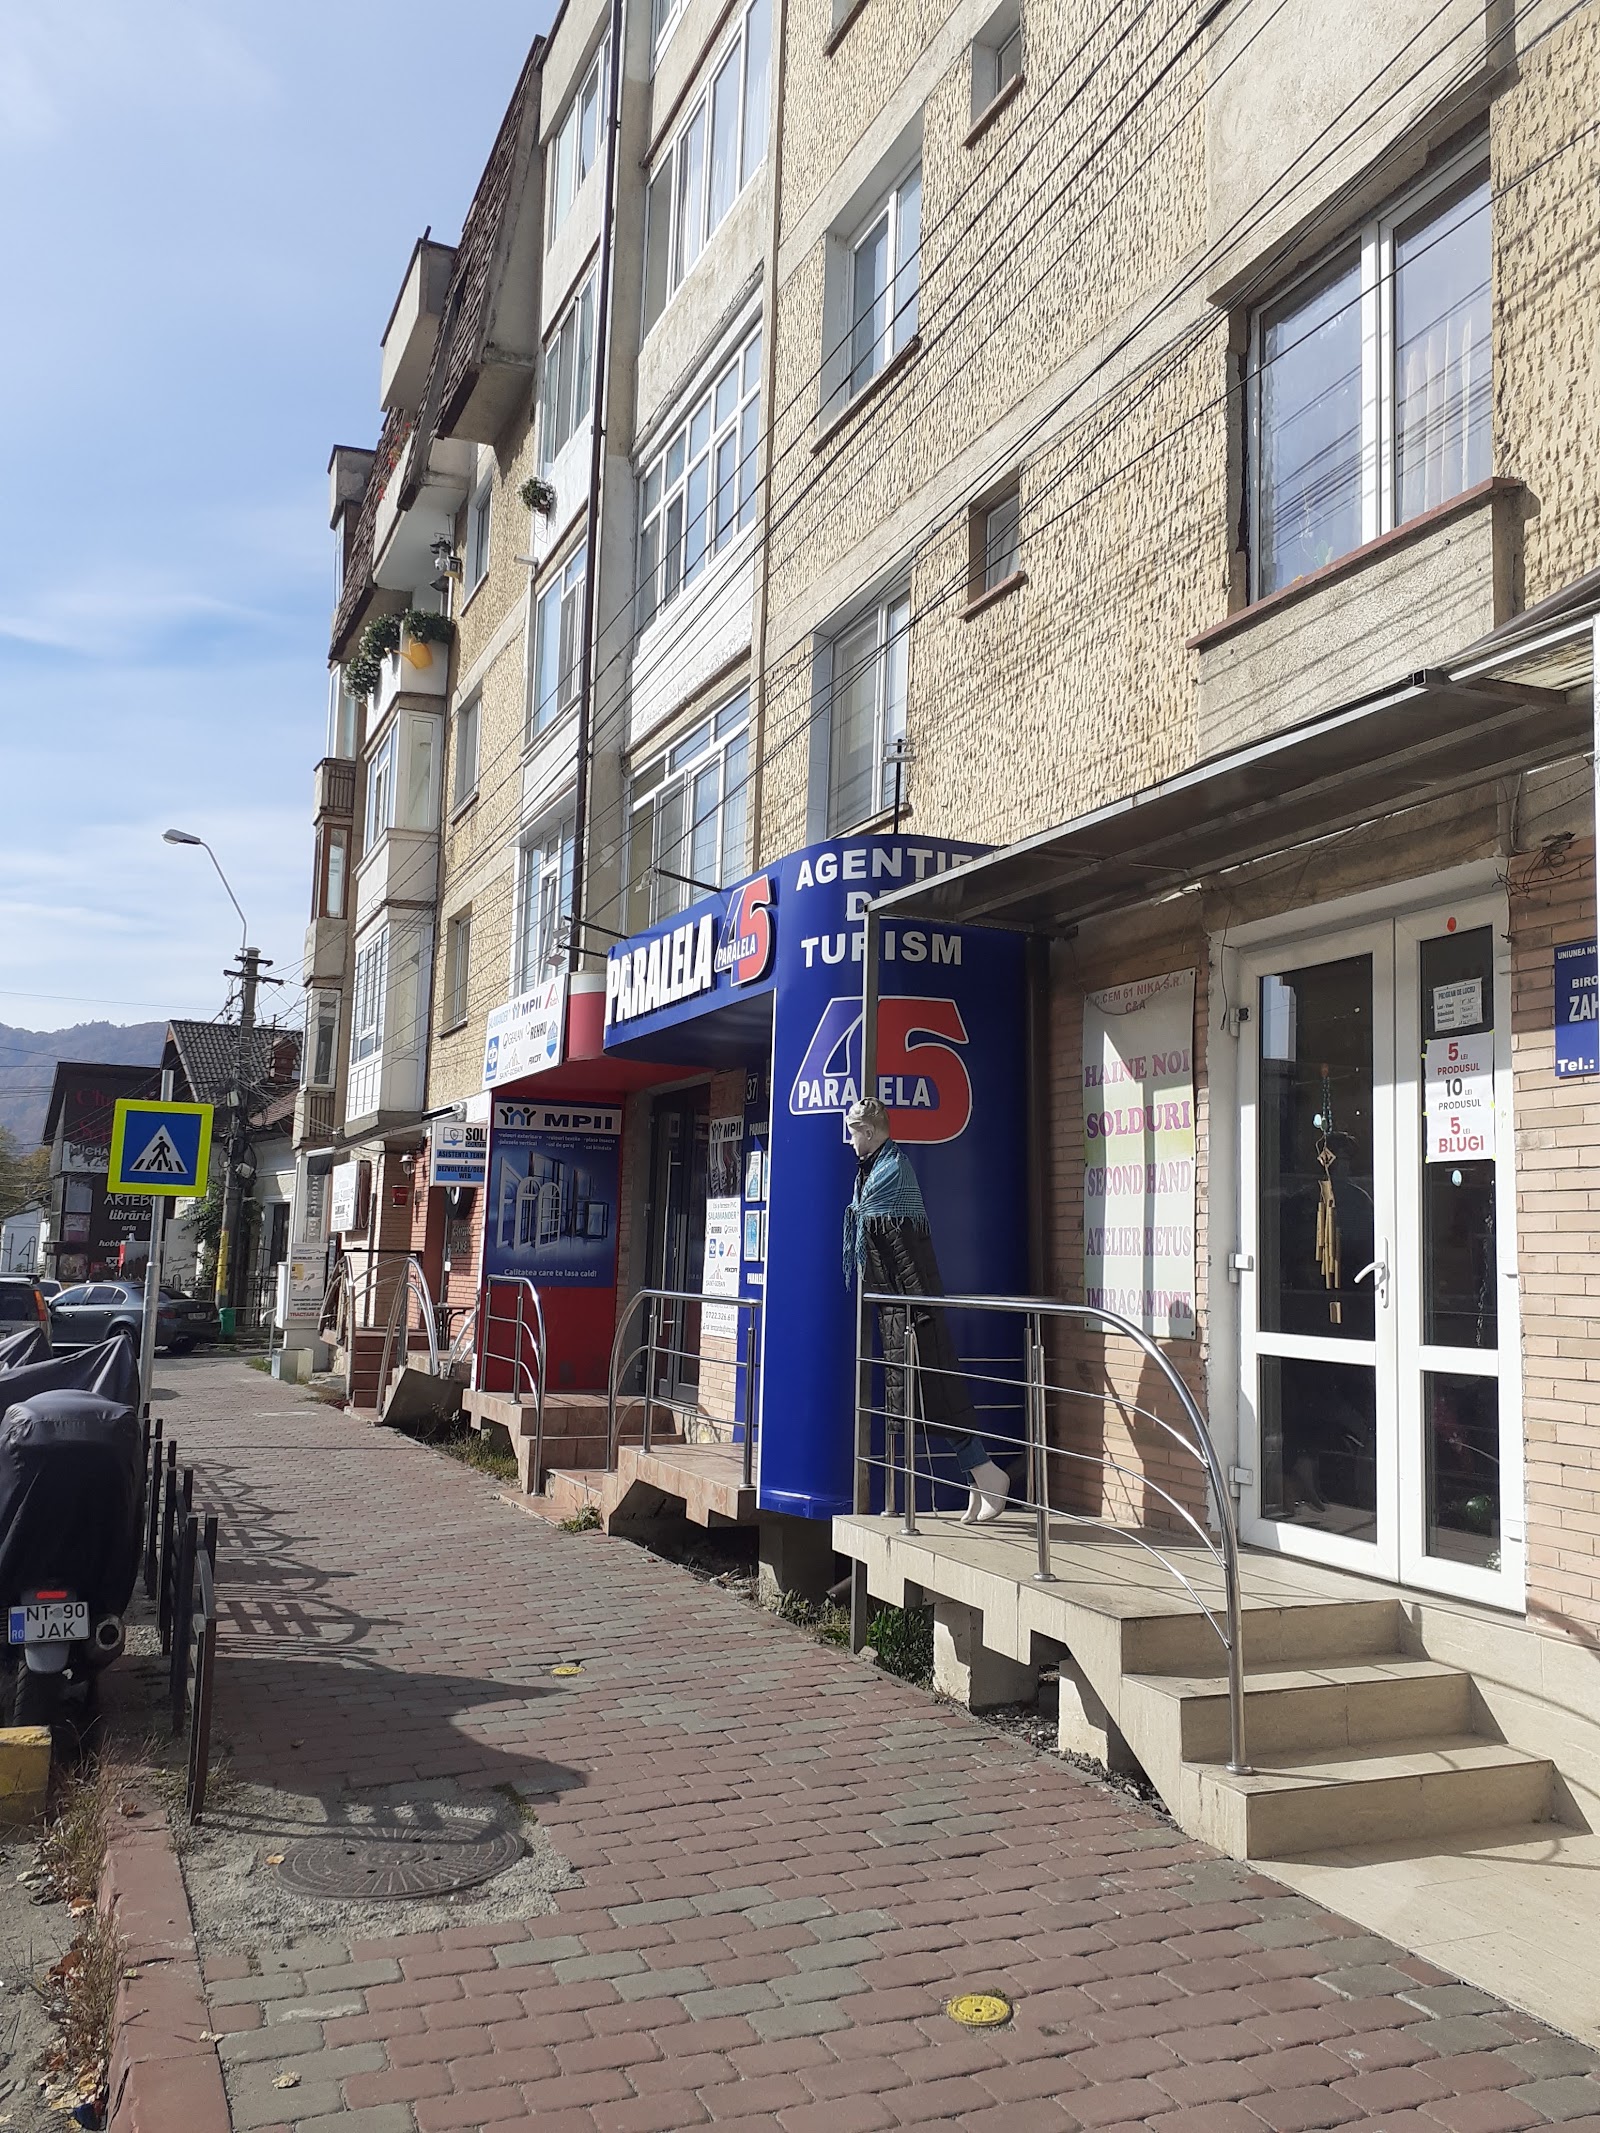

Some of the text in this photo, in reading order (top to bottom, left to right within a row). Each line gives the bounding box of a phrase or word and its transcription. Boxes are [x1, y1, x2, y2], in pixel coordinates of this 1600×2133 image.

[846, 891, 905, 922] D
[714, 874, 771, 987] 45
[717, 934, 756, 968] PARALELA
[1558, 948, 1586, 959] UNIUNEA
[606, 914, 712, 1026] PARALELA
[1123, 987, 1133, 999] 61
[1136, 983, 1160, 995] NIKA
[1572, 975, 1598, 989] BIRO
[521, 996, 542, 1016] MPII
[1125, 1000, 1146, 1012] C&A
[1448, 1042, 1459, 1061] 5
[789, 995, 973, 1144] 45
[1085, 1049, 1190, 1087] HAINE NOI
[1437, 1062, 1480, 1076] PRODUSUL
[1557, 1057, 1595, 1072] Tel.:
[747, 1078, 757, 1100] 37
[798, 1076, 931, 1109] PARAELA
[1445, 1078, 1463, 1097] 10
[1438, 1099, 1481, 1110] PRODUSUL
[544, 1113, 613, 1130] MPII
[1086, 1101, 1191, 1139] SOLDURI
[1450, 1117, 1460, 1135] 5
[723, 1122, 742, 1138] MPII
[1438, 1135, 1484, 1153] BLUGI
[1088, 1160, 1191, 1197] SECOND HAND
[99, 1239, 121, 1247] hobb
[1086, 1226, 1191, 1257] ATELIER RETUS
[504, 1268, 537, 1276] Calitatea
[1086, 1287, 1192, 1319] IMBRACAMINTE
[27, 1603, 85, 1621] NT 90
[12, 1629, 24, 1640] RO
[37, 1622, 75, 1639] JAK
